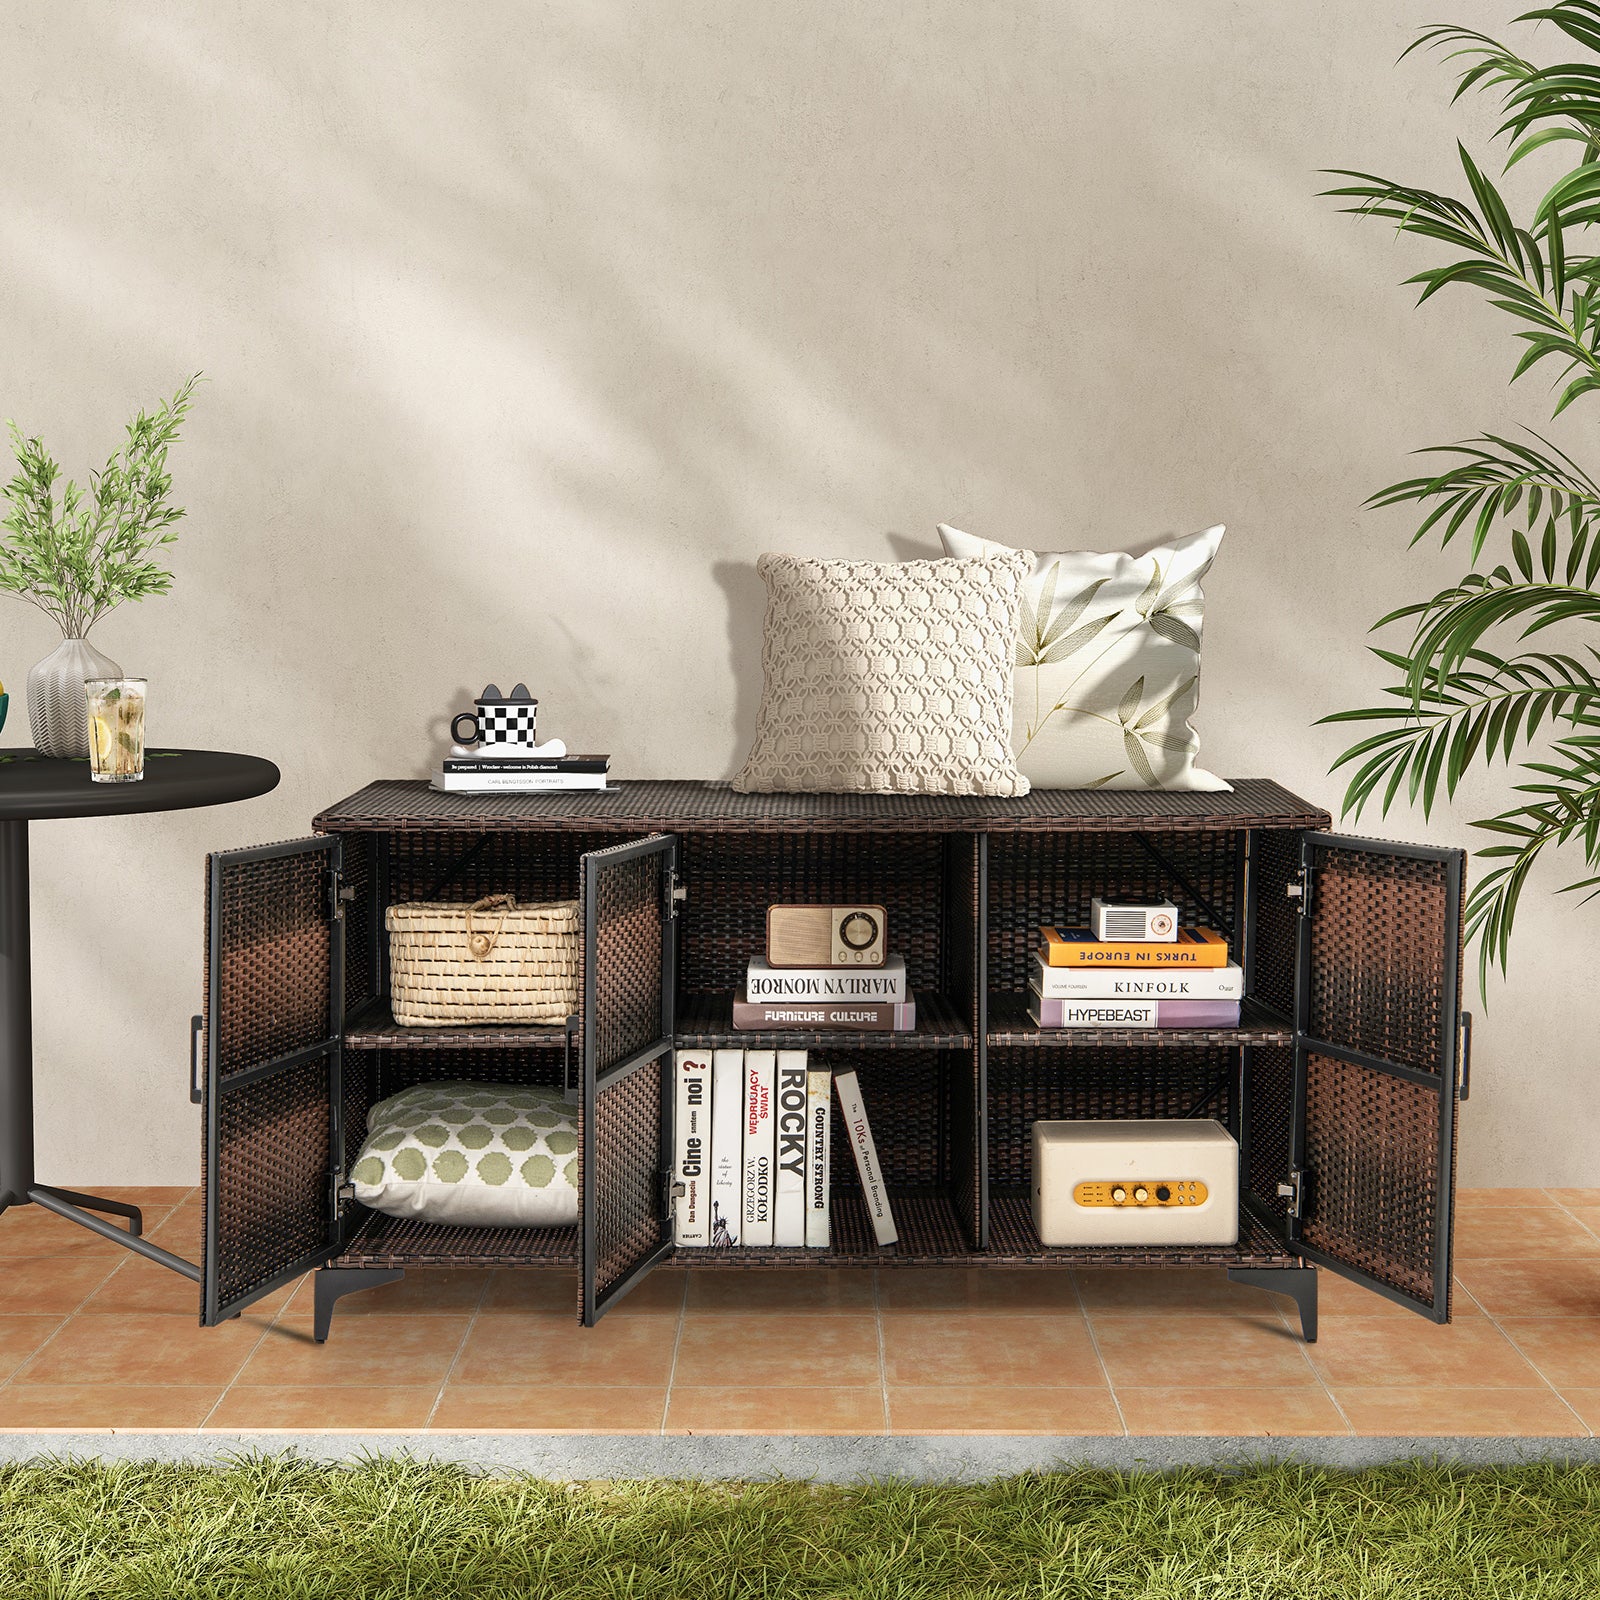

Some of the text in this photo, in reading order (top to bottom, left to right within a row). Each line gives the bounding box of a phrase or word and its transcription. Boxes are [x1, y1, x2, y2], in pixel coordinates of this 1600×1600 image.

[1079, 952, 1197, 962] TURKS IN EUROPE
[751, 978, 897, 995] MARILYN MONROE
[1114, 982, 1190, 993] KINFOLK
[830, 1011, 878, 1022] CULTURE
[1068, 1009, 1151, 1022] HYPEBEAST
[684, 1078, 702, 1106] noi
[749, 1069, 760, 1135] WĘDRUJĄCY
[758, 1086, 768, 1119] ŚWIAT
[780, 1069, 806, 1178] ROCKY
[682, 1138, 702, 1176] Cine
[814, 1107, 826, 1209] COUNTRY STRONG
[853, 1118, 868, 1144] 10Ks
[862, 1150, 876, 1184] Personal
[871, 1185, 884, 1218] Branding
[688, 1180, 697, 1210] Dungaciu
[746, 1170, 756, 1223] GRZEGORZ
[757, 1156, 768, 1222] KOŁODKO
